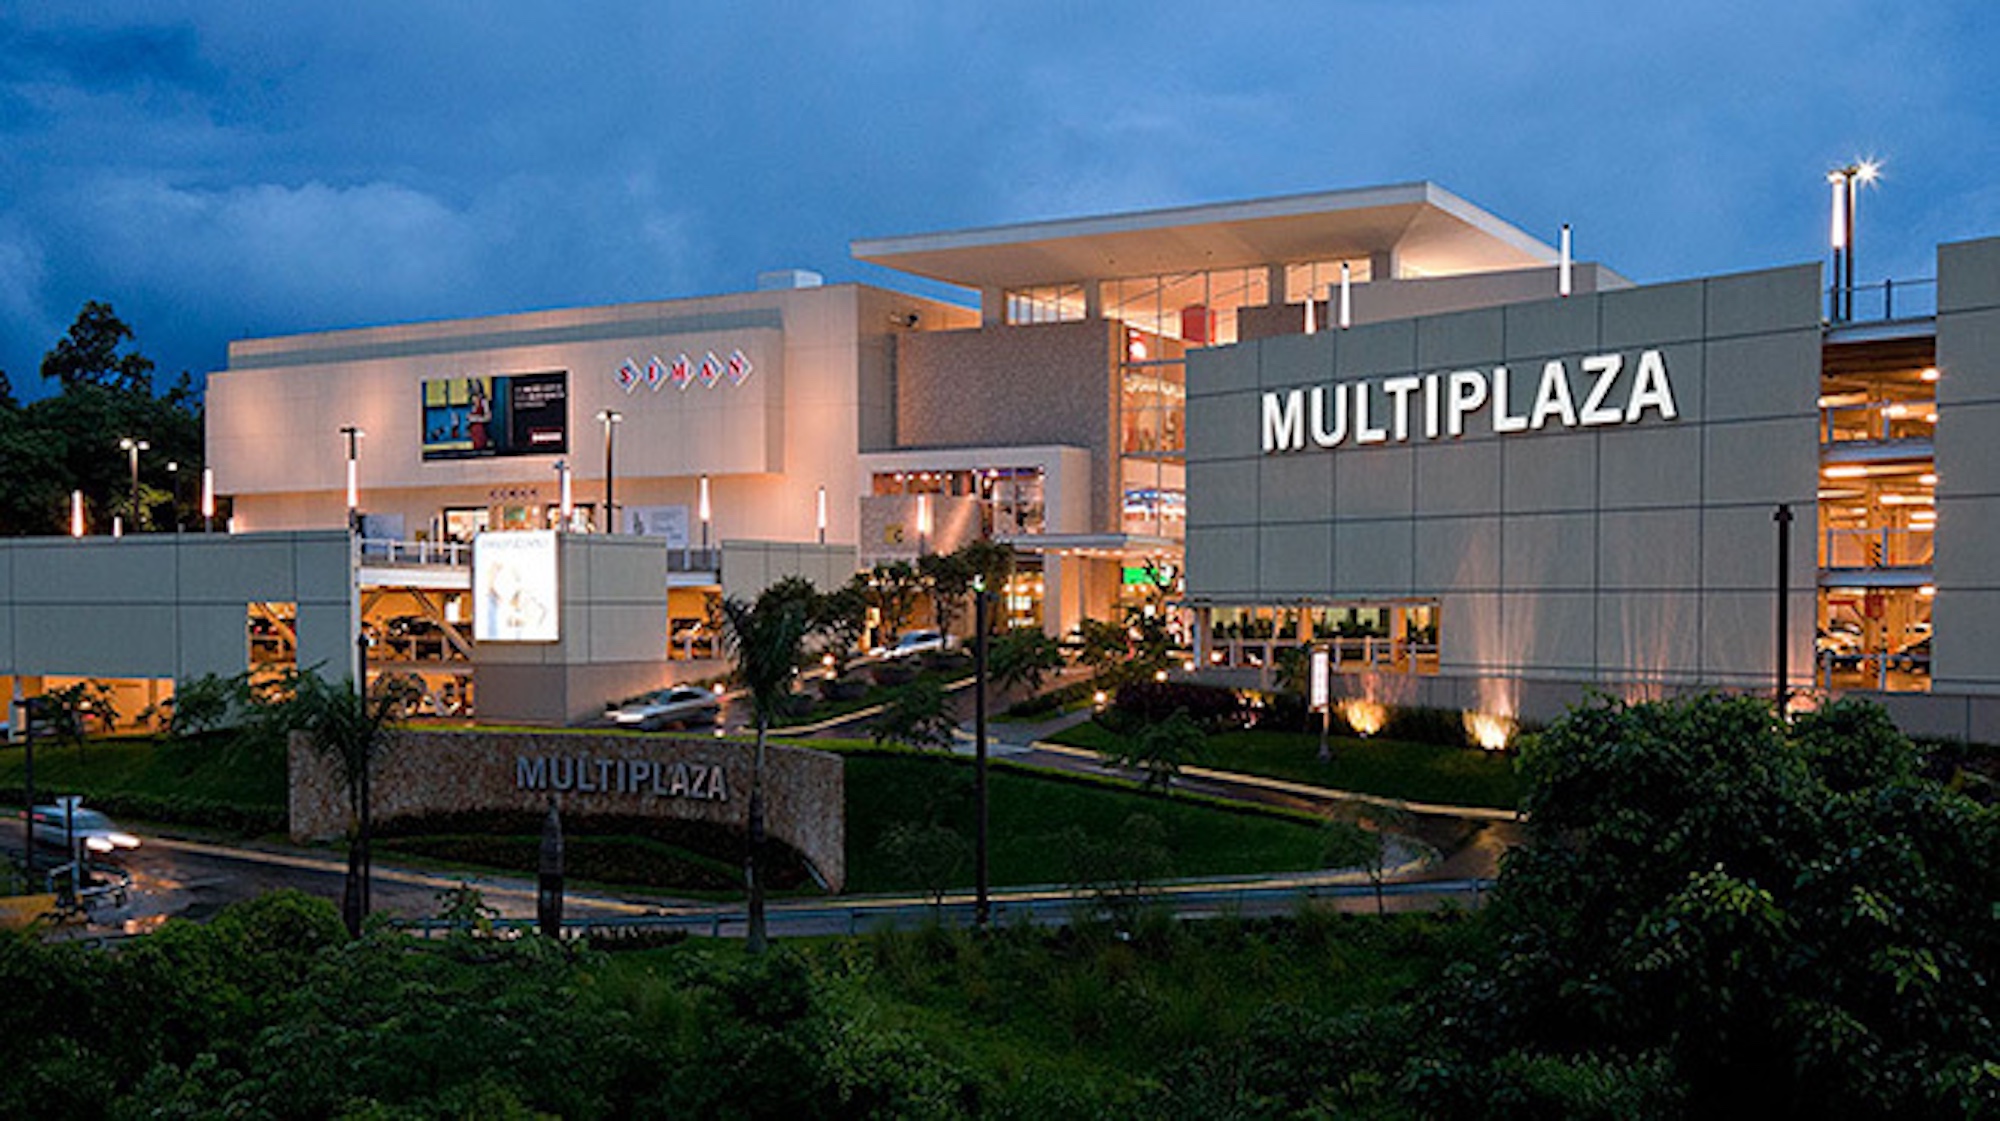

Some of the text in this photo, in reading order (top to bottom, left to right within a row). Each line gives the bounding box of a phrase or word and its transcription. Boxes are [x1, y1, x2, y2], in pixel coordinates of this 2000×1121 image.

[617, 356, 744, 385] SIMAN
[1261, 349, 1677, 451] MULTIPLAZA
[516, 756, 727, 801] MULTIPLAZA
